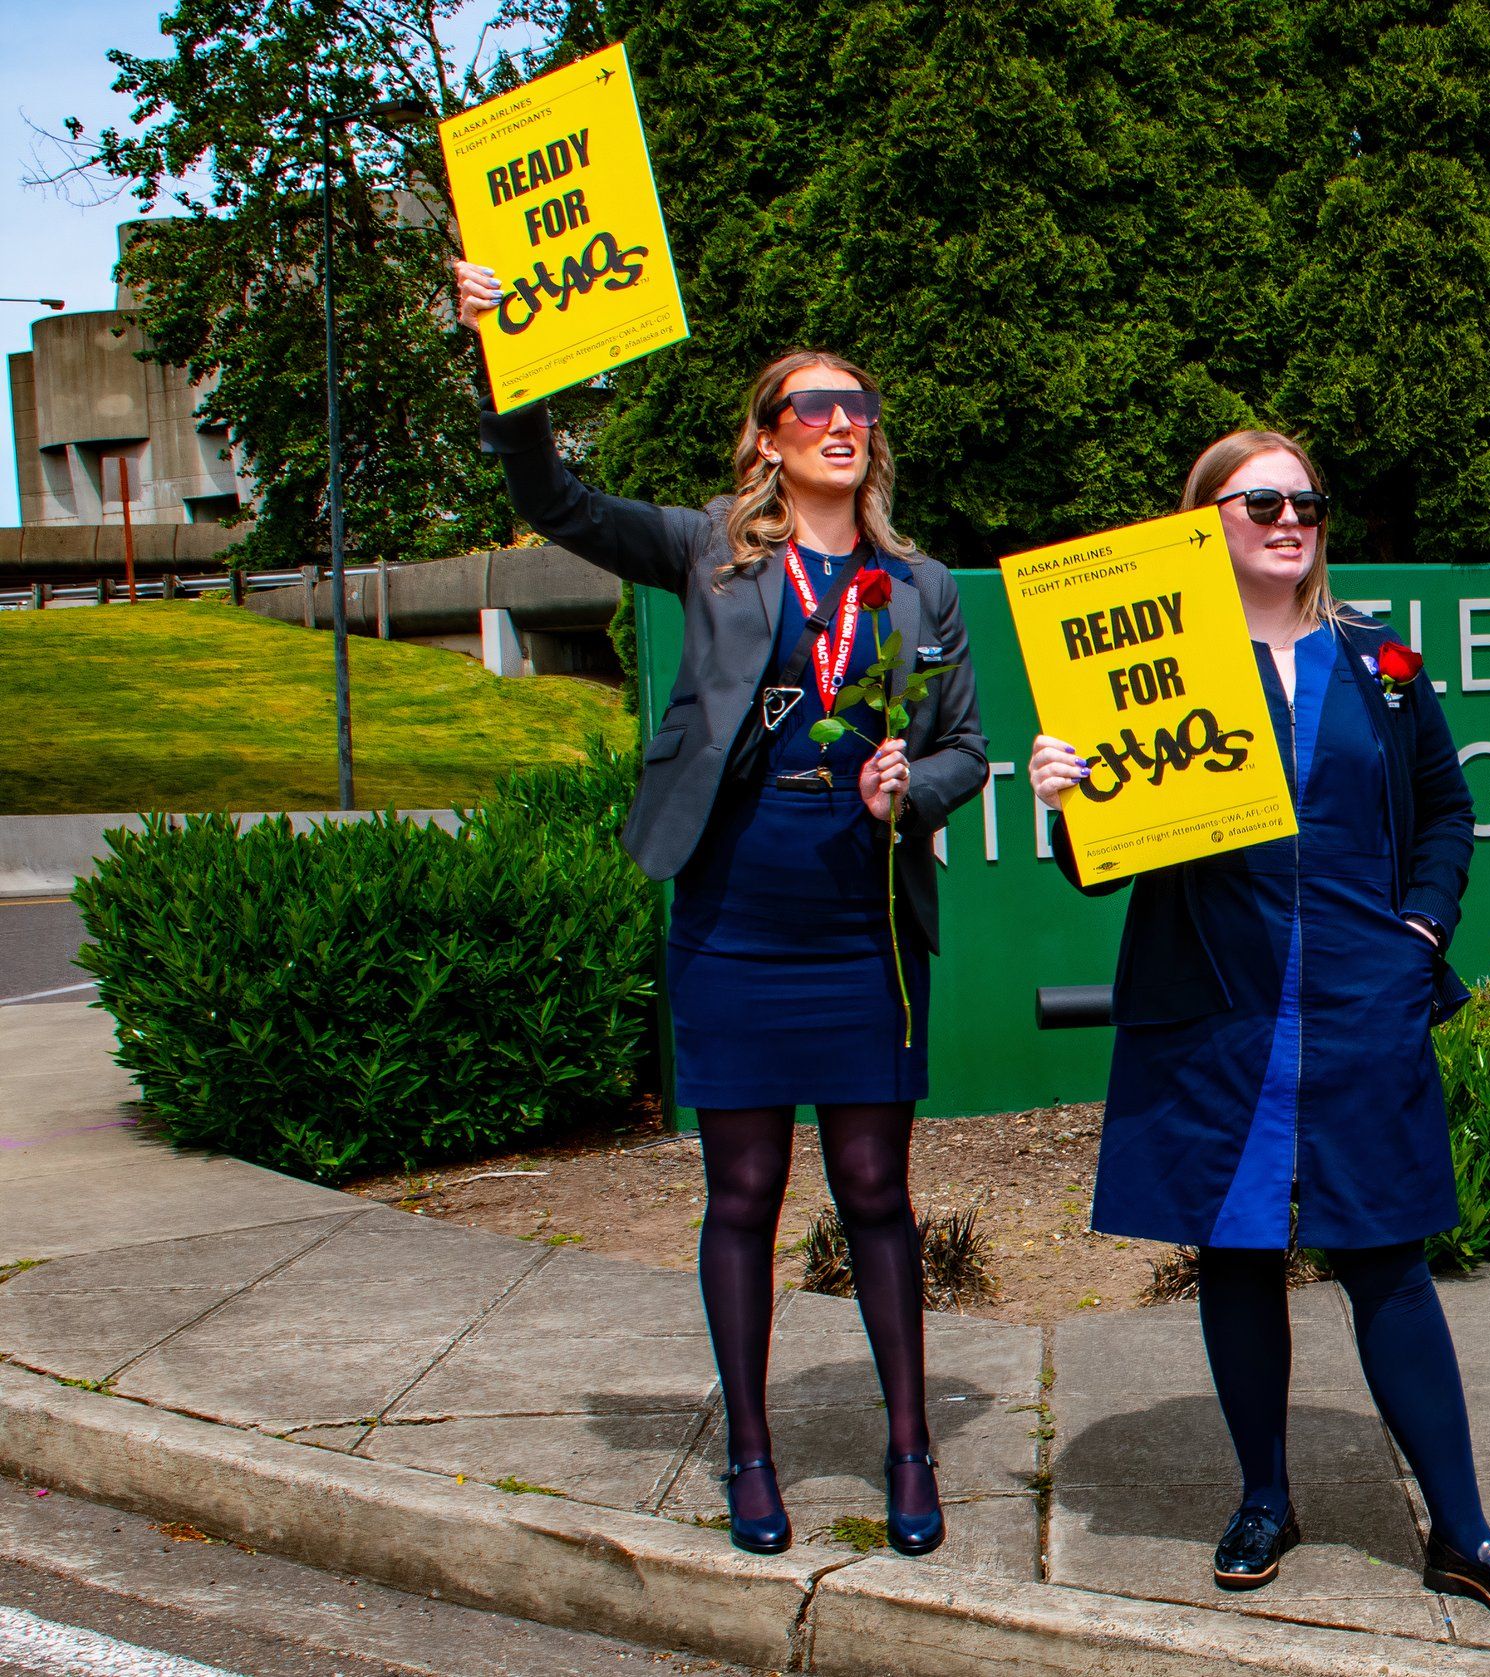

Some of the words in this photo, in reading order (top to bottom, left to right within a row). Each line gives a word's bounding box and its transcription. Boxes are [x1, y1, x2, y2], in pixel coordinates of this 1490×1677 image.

[452, 118, 488, 140] ALASKA
[490, 98, 533, 122] AIRLINES
[455, 136, 488, 157] FLIGHT
[490, 107, 553, 142] ATTENDANTS
[486, 128, 590, 207] READY
[524, 188, 590, 247] FOR
[497, 231, 649, 335] CHAOS
[501, 366, 545, 388] Association
[1017, 559, 1060, 578] ALASKA
[1062, 546, 1113, 566] AIRLINES
[1021, 580, 1061, 598] FLIGHT
[1064, 561, 1138, 588] ATTENDANTS
[842, 612, 855, 639] NOW
[1060, 591, 1184, 661] READY
[1107, 656, 1186, 712] FOR
[1078, 708, 1254, 803] CHAOS
[1086, 839, 1135, 858] Association
[1135, 834, 1145, 845] of
[1146, 830, 1170, 843] Flight
[1228, 817, 1284, 837] afaalaska.org
